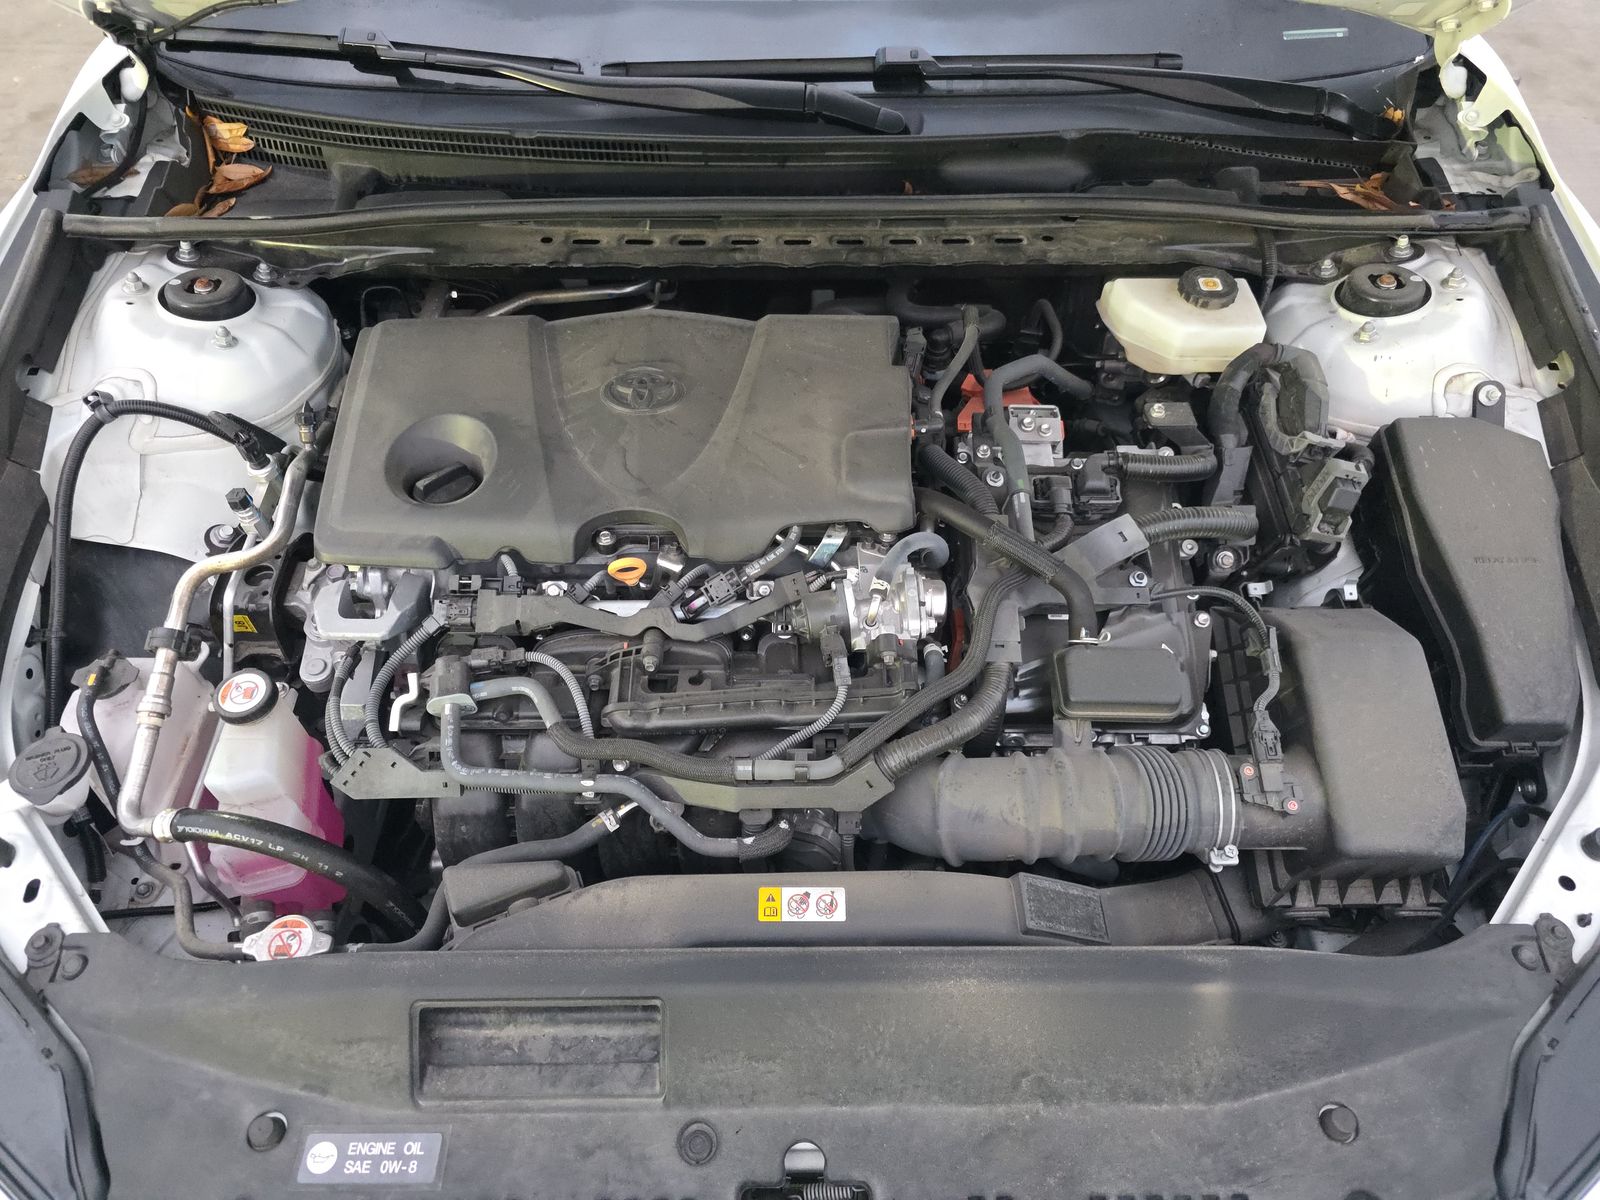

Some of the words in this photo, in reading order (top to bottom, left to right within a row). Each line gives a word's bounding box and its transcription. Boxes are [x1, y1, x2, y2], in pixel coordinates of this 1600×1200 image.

[176, 825, 220, 836] YOKOHAMA
[347, 1141, 397, 1156] ENGINE
[403, 1141, 425, 1156] OIL
[343, 1160, 372, 1174] SAE
[379, 1160, 418, 1174] 0W-8
